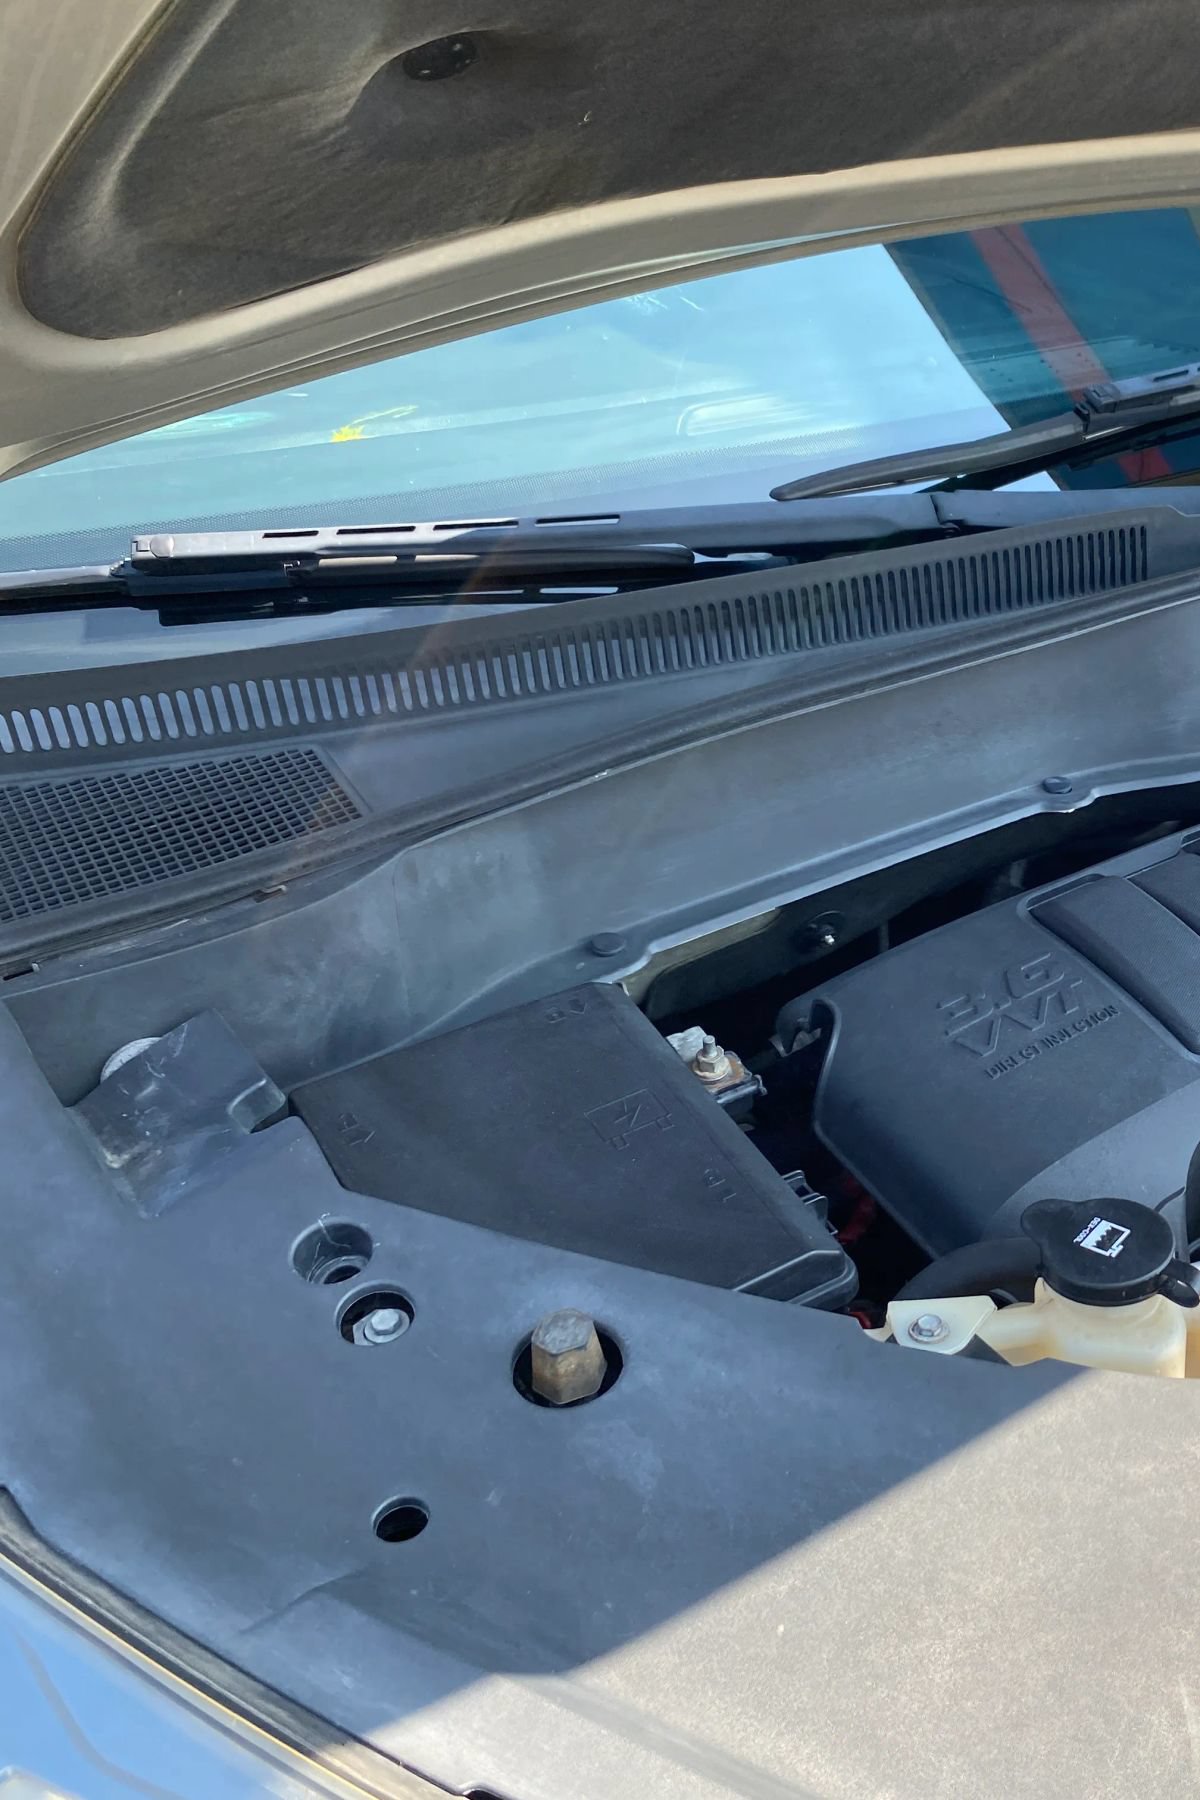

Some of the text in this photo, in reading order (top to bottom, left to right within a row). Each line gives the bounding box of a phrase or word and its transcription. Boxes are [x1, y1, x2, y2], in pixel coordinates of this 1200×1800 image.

[936, 952, 1066, 1037] 3.6
[985, 1004, 1122, 1081] DIRECT INJECTION
